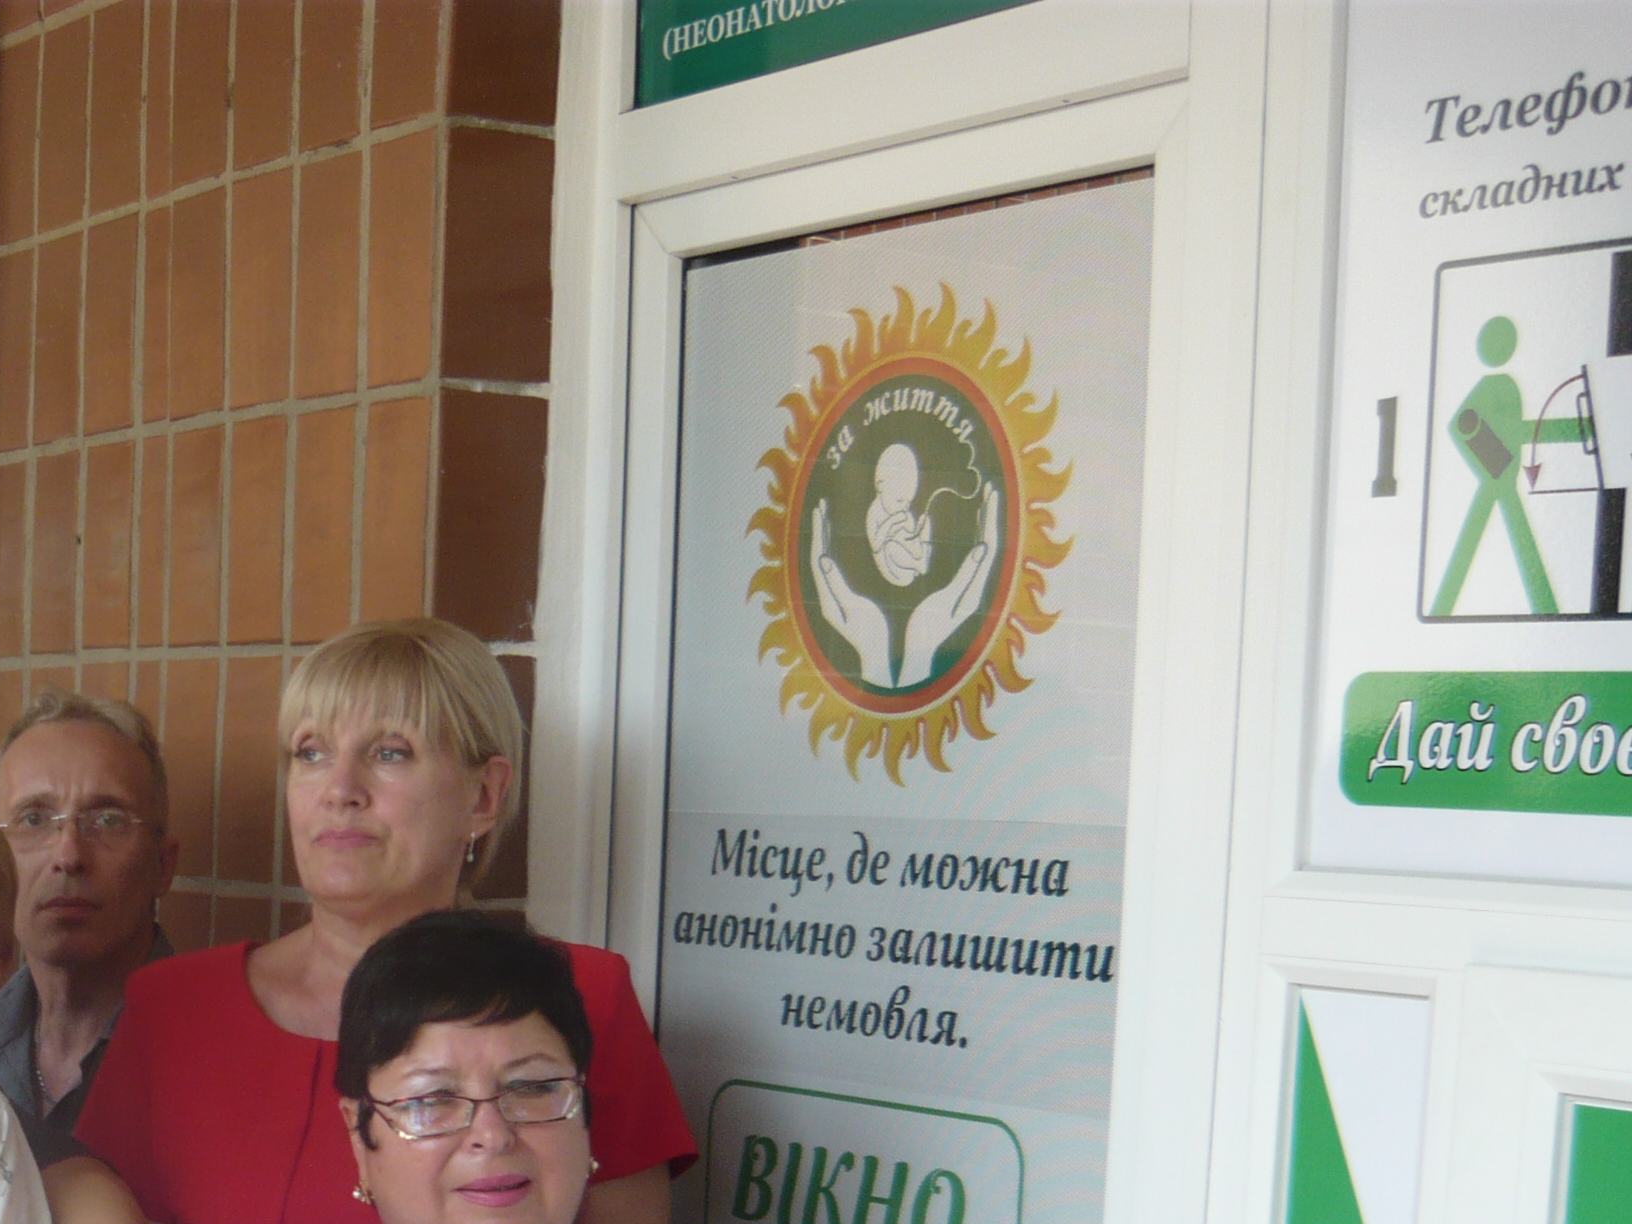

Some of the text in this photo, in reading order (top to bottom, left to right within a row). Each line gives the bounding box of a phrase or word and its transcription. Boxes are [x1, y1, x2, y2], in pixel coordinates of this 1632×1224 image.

[663, 0, 847, 60] (НЕОНАТОЛ
[1424, 71, 1632, 144] Телефо
[1419, 163, 1624, 219] складних
[827, 387, 974, 470] за життя
[1371, 396, 1398, 498] 1
[1366, 699, 1495, 785] Дай
[711, 828, 1071, 898] Місце, де можна
[673, 903, 1115, 983] анонімно залишити
[780, 985, 968, 1049] немовля.
